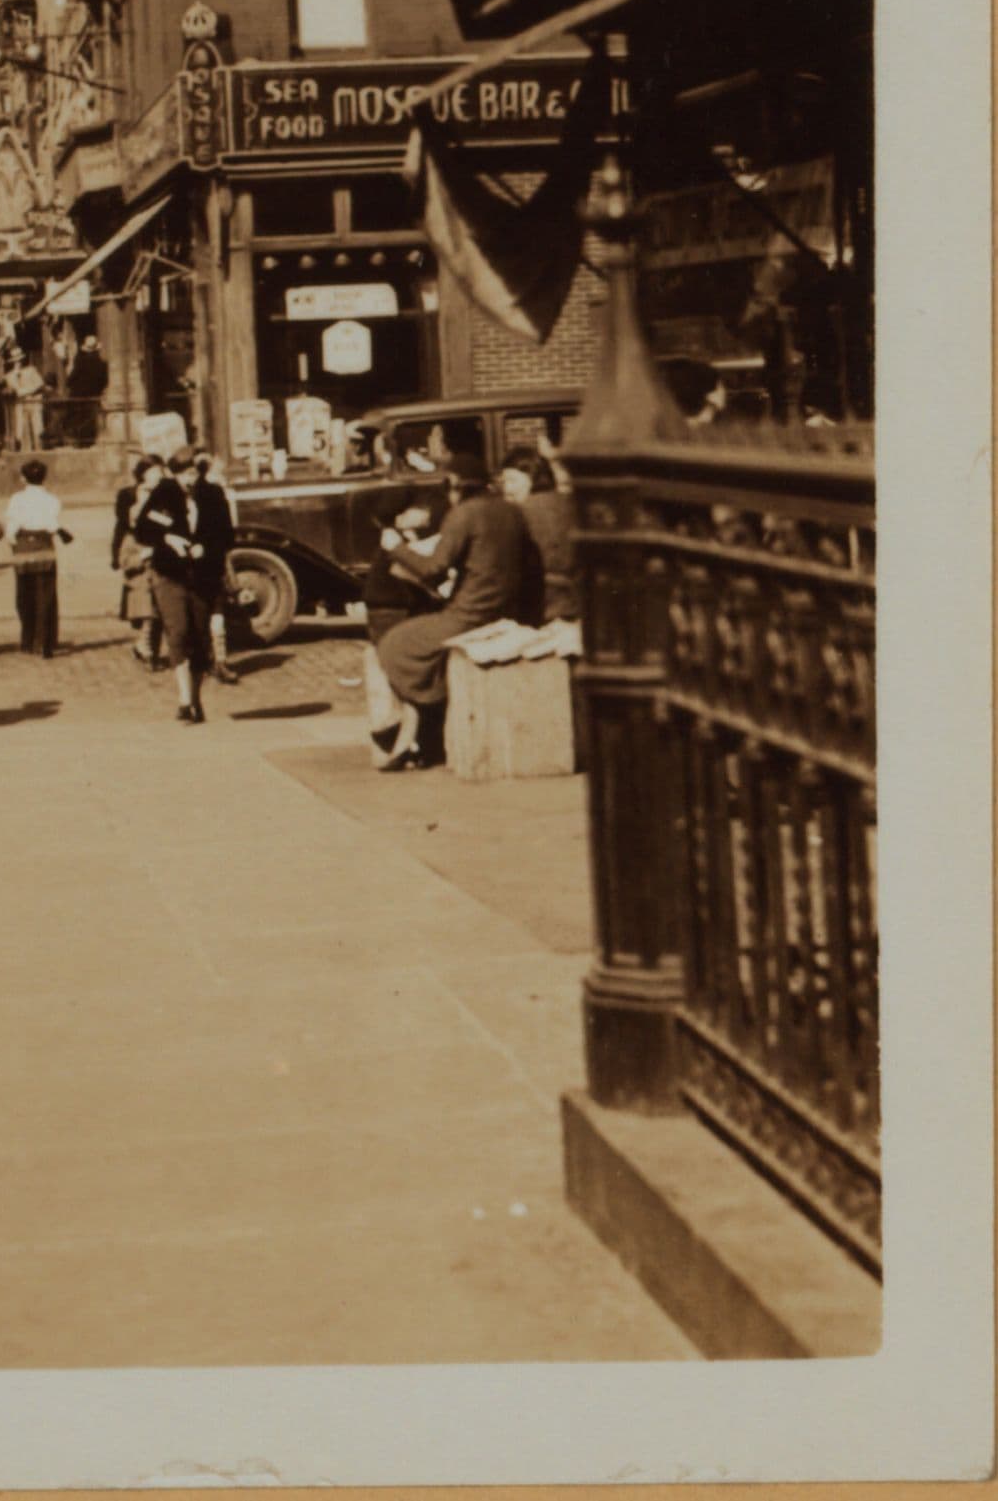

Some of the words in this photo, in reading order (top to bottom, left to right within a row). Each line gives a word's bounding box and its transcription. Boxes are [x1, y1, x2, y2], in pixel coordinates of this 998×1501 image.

[264, 78, 319, 104] SEA
[479, 81, 541, 121] BAR
[260, 115, 326, 143] FOOD
